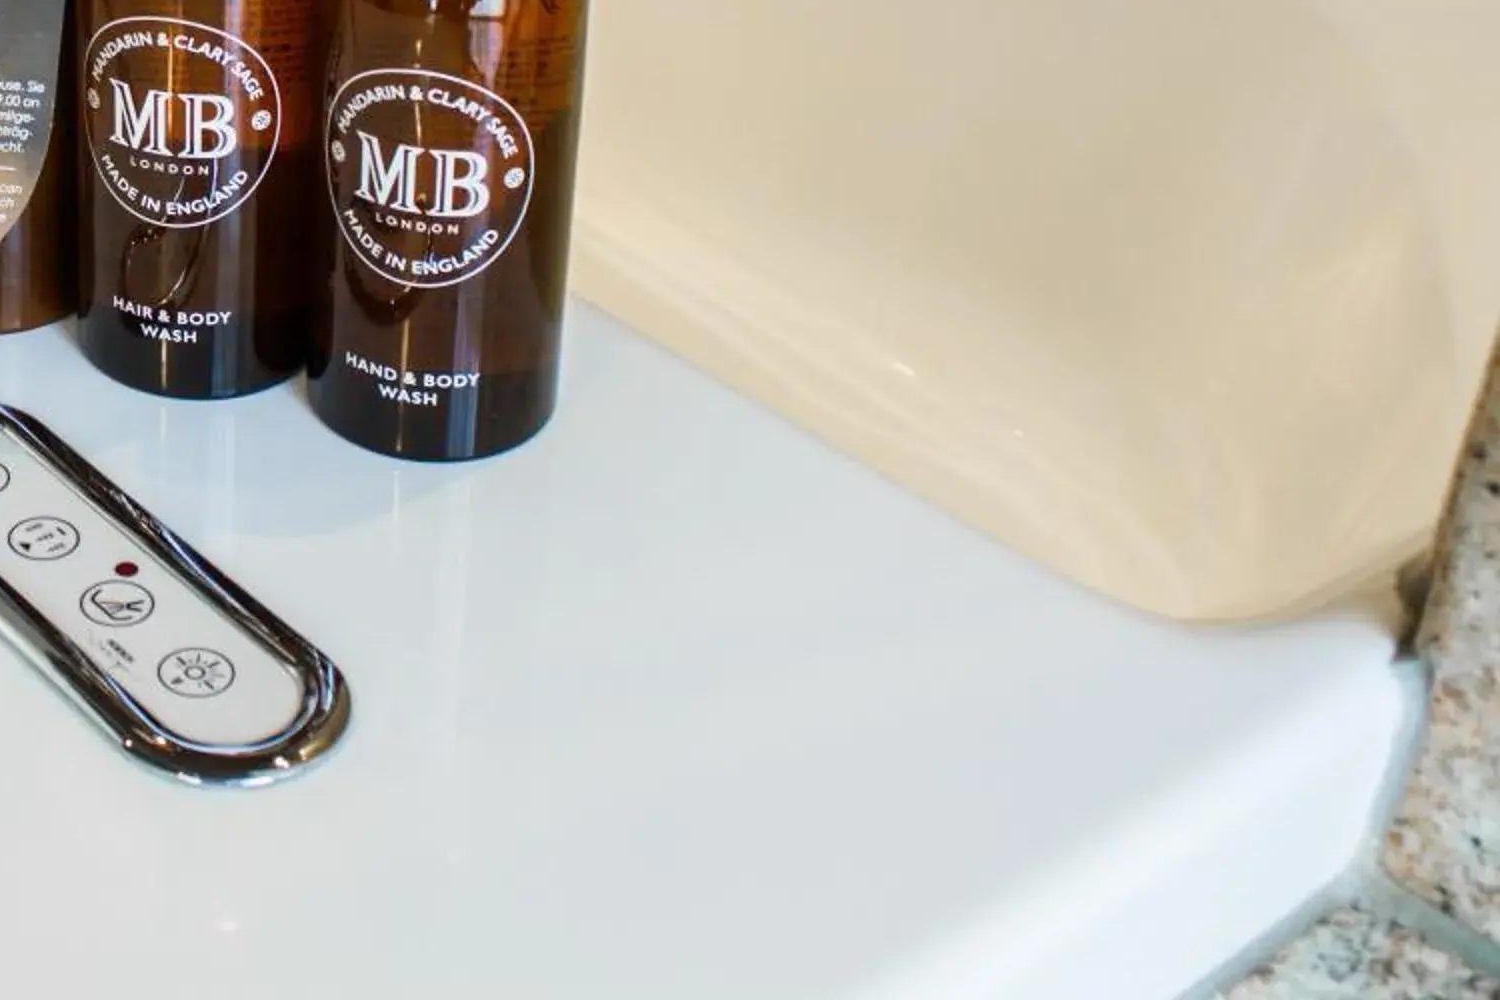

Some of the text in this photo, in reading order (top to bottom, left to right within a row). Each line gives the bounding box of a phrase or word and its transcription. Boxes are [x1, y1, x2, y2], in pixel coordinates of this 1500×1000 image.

[91, 32, 265, 101] MANDARIN & CLARY SAGE
[23, 97, 41, 109] an
[27, 80, 45, 93] Sie
[109, 78, 237, 159] MB
[336, 84, 518, 160] MANDARIN & CLARY SAGE
[130, 155, 210, 176] LONDON
[354, 129, 490, 218] MB
[100, 154, 249, 216] MADE IN ENGLAND
[374, 213, 460, 235] LONDON
[344, 208, 500, 276] MADE IN ENGLAND
[113, 295, 233, 326] HAIR & BODY
[140, 323, 198, 344] WASH
[345, 350, 481, 389] HAND & BODY
[378, 382, 438, 407] WASH
